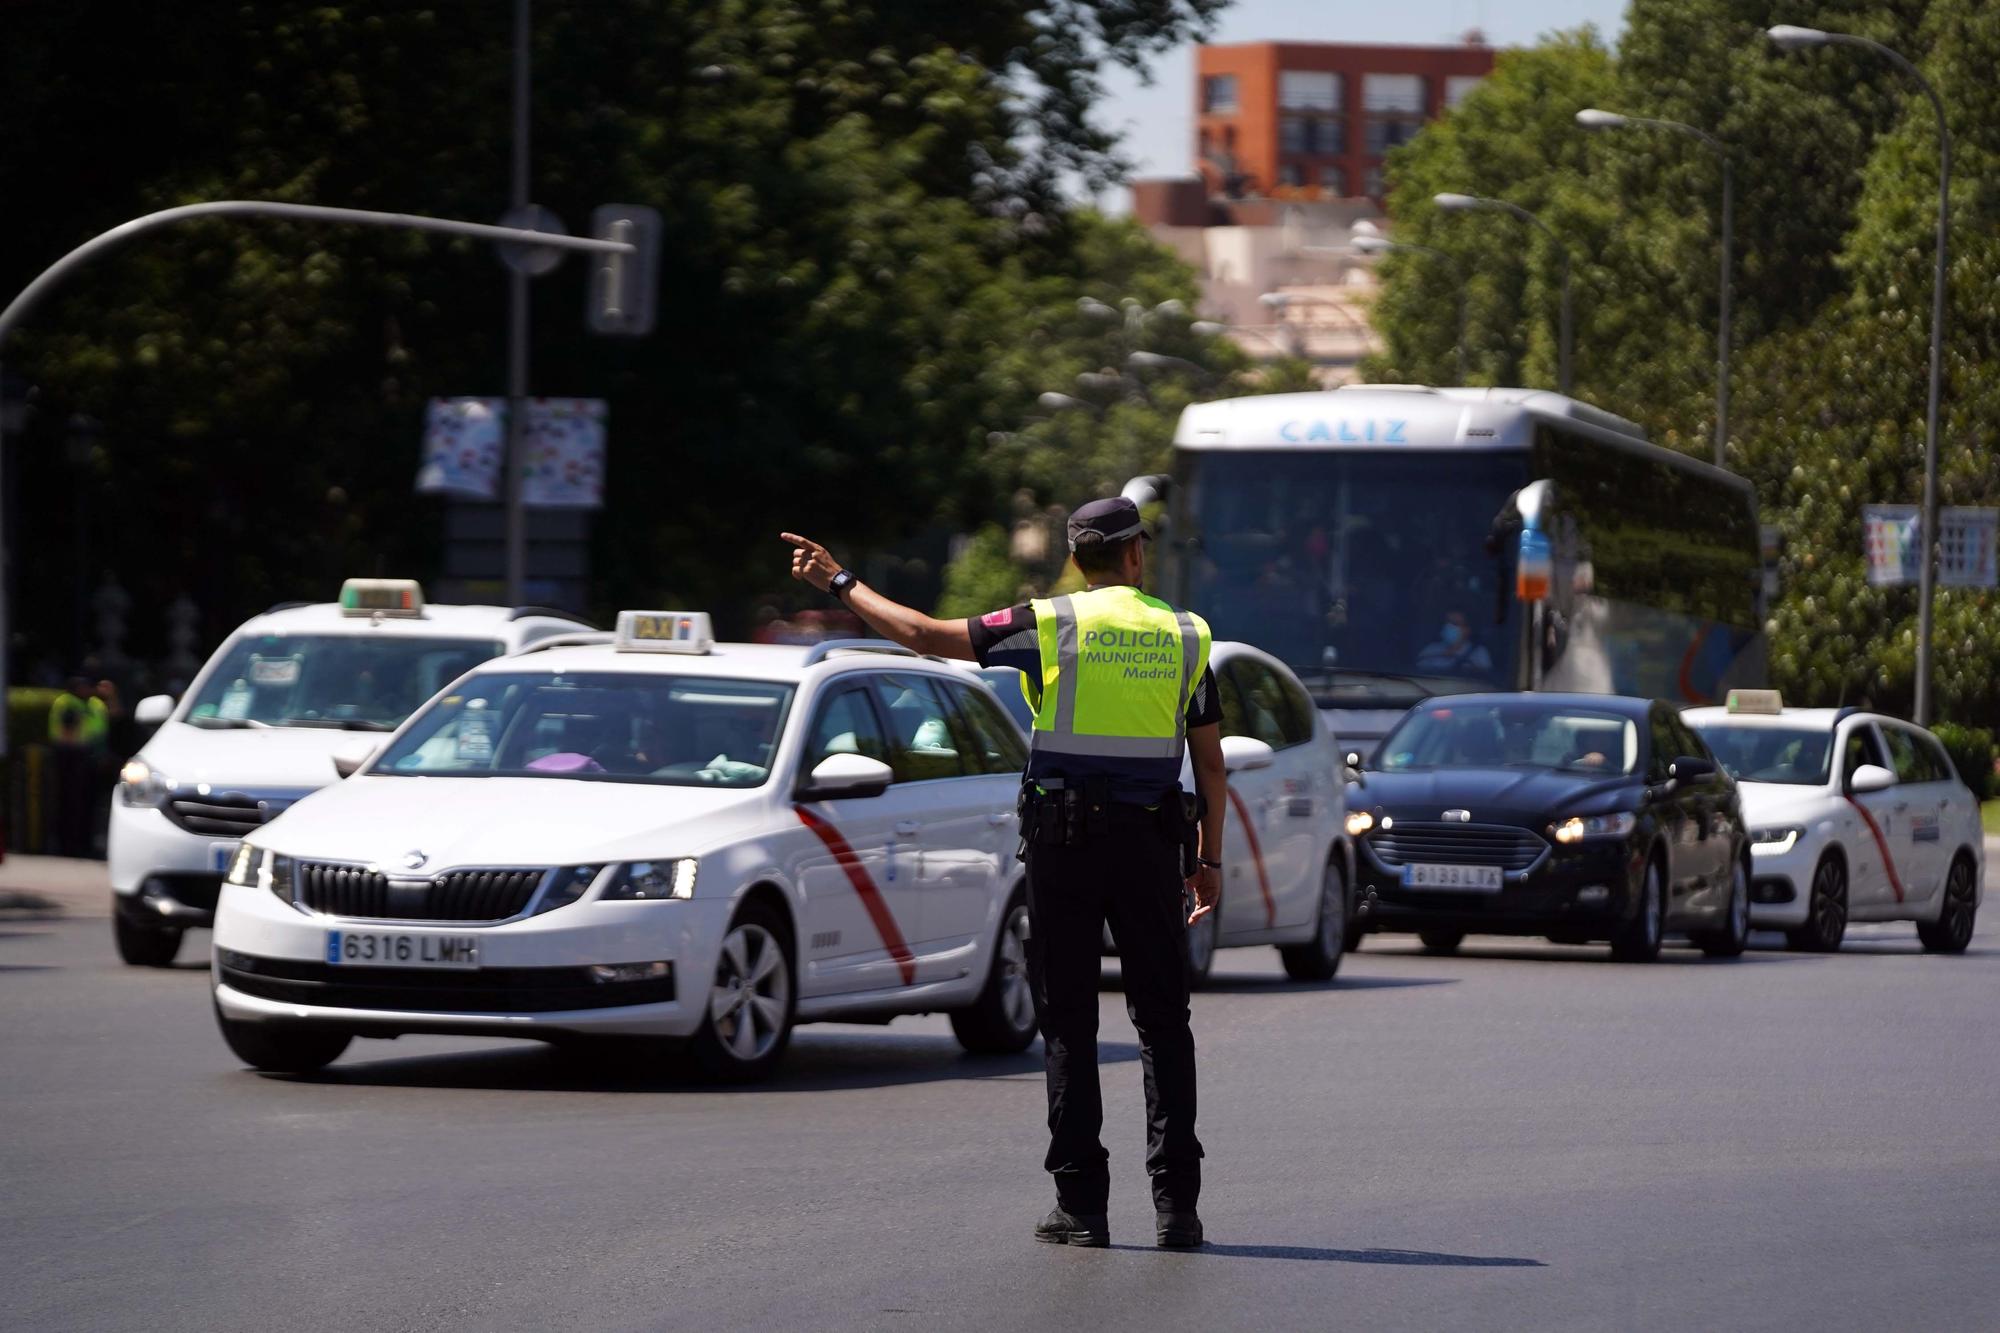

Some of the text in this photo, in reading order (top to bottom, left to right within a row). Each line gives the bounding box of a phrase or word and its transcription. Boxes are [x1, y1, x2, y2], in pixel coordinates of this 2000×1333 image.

[1280, 418, 1409, 442] CALIZ
[1085, 627, 1176, 648] POLICÍA
[1085, 652, 1177, 665] MUNICIPAL
[1123, 667, 1177, 679] Madrid
[344, 934, 476, 962] 6316 LMH
